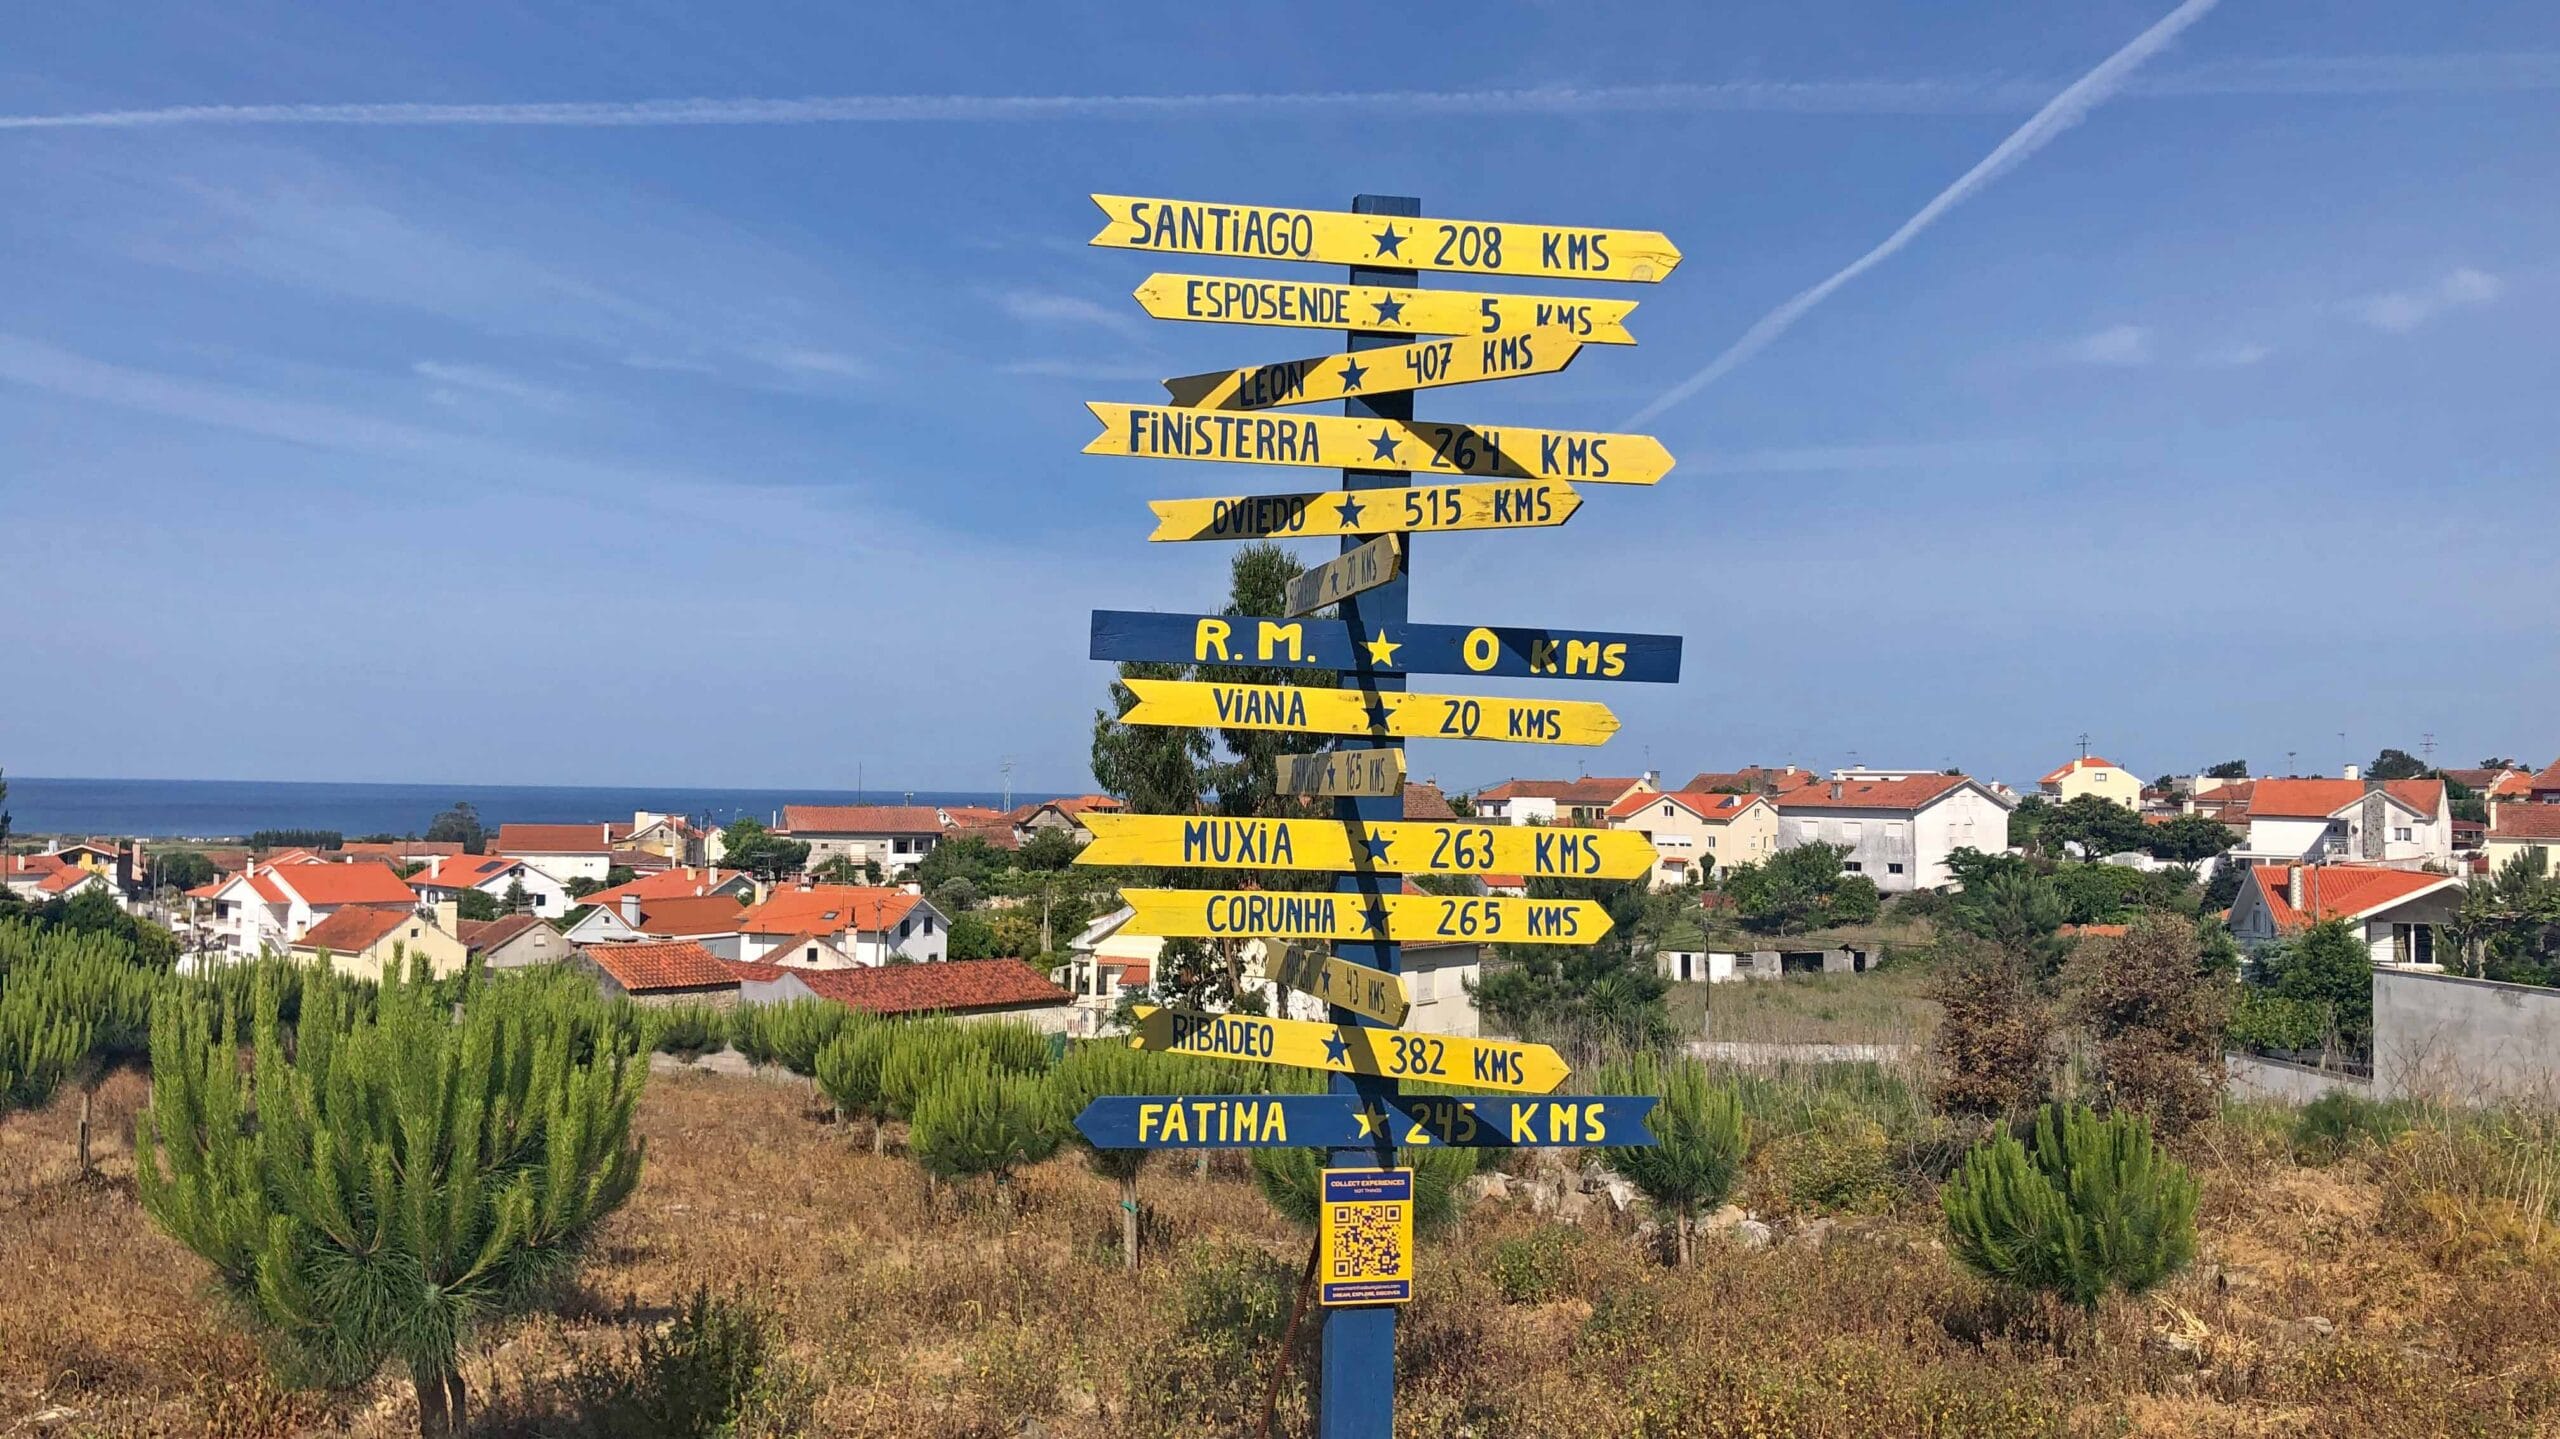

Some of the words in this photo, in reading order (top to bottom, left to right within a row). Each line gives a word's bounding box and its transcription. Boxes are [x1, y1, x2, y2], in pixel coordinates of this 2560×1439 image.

[1435, 225, 1503, 269] 208
[1542, 234, 1609, 272] KMS
[1186, 281, 1351, 325] ESPOSENDE
[1482, 299, 1500, 333] 5
[1537, 304, 1592, 335] KMS
[1239, 362, 1306, 408] LEON
[1406, 343, 1454, 384] 407
[1483, 334, 1534, 375] KMS
[1431, 429, 1501, 470] 264
[1541, 434, 1608, 478] KMS
[1404, 488, 1462, 527] 515
[1494, 486, 1551, 523] KMS
[1362, 545, 1377, 585] KMS
[1530, 636, 1627, 677] KMS
[1440, 701, 1480, 735] 20
[1509, 707, 1562, 740] KMS
[1346, 753, 1361, 792] 165
[1370, 758, 1385, 792] KMS
[1430, 828, 1494, 870] 263
[1535, 832, 1601, 875] KMS
[1206, 894, 1337, 934] CORUNHA
[1437, 899, 1502, 936] 265
[1527, 906, 1578, 937] KMS
[1346, 967, 1359, 1005] 43
[1368, 978, 1386, 1014] KMS
[1389, 1036, 1446, 1076] 382
[1474, 1046, 1525, 1086] KMS
[1404, 1103, 1477, 1145] 245
[1511, 1103, 1606, 1143] KMS
[1361, 1179, 1405, 1187] EXPERIENCES
